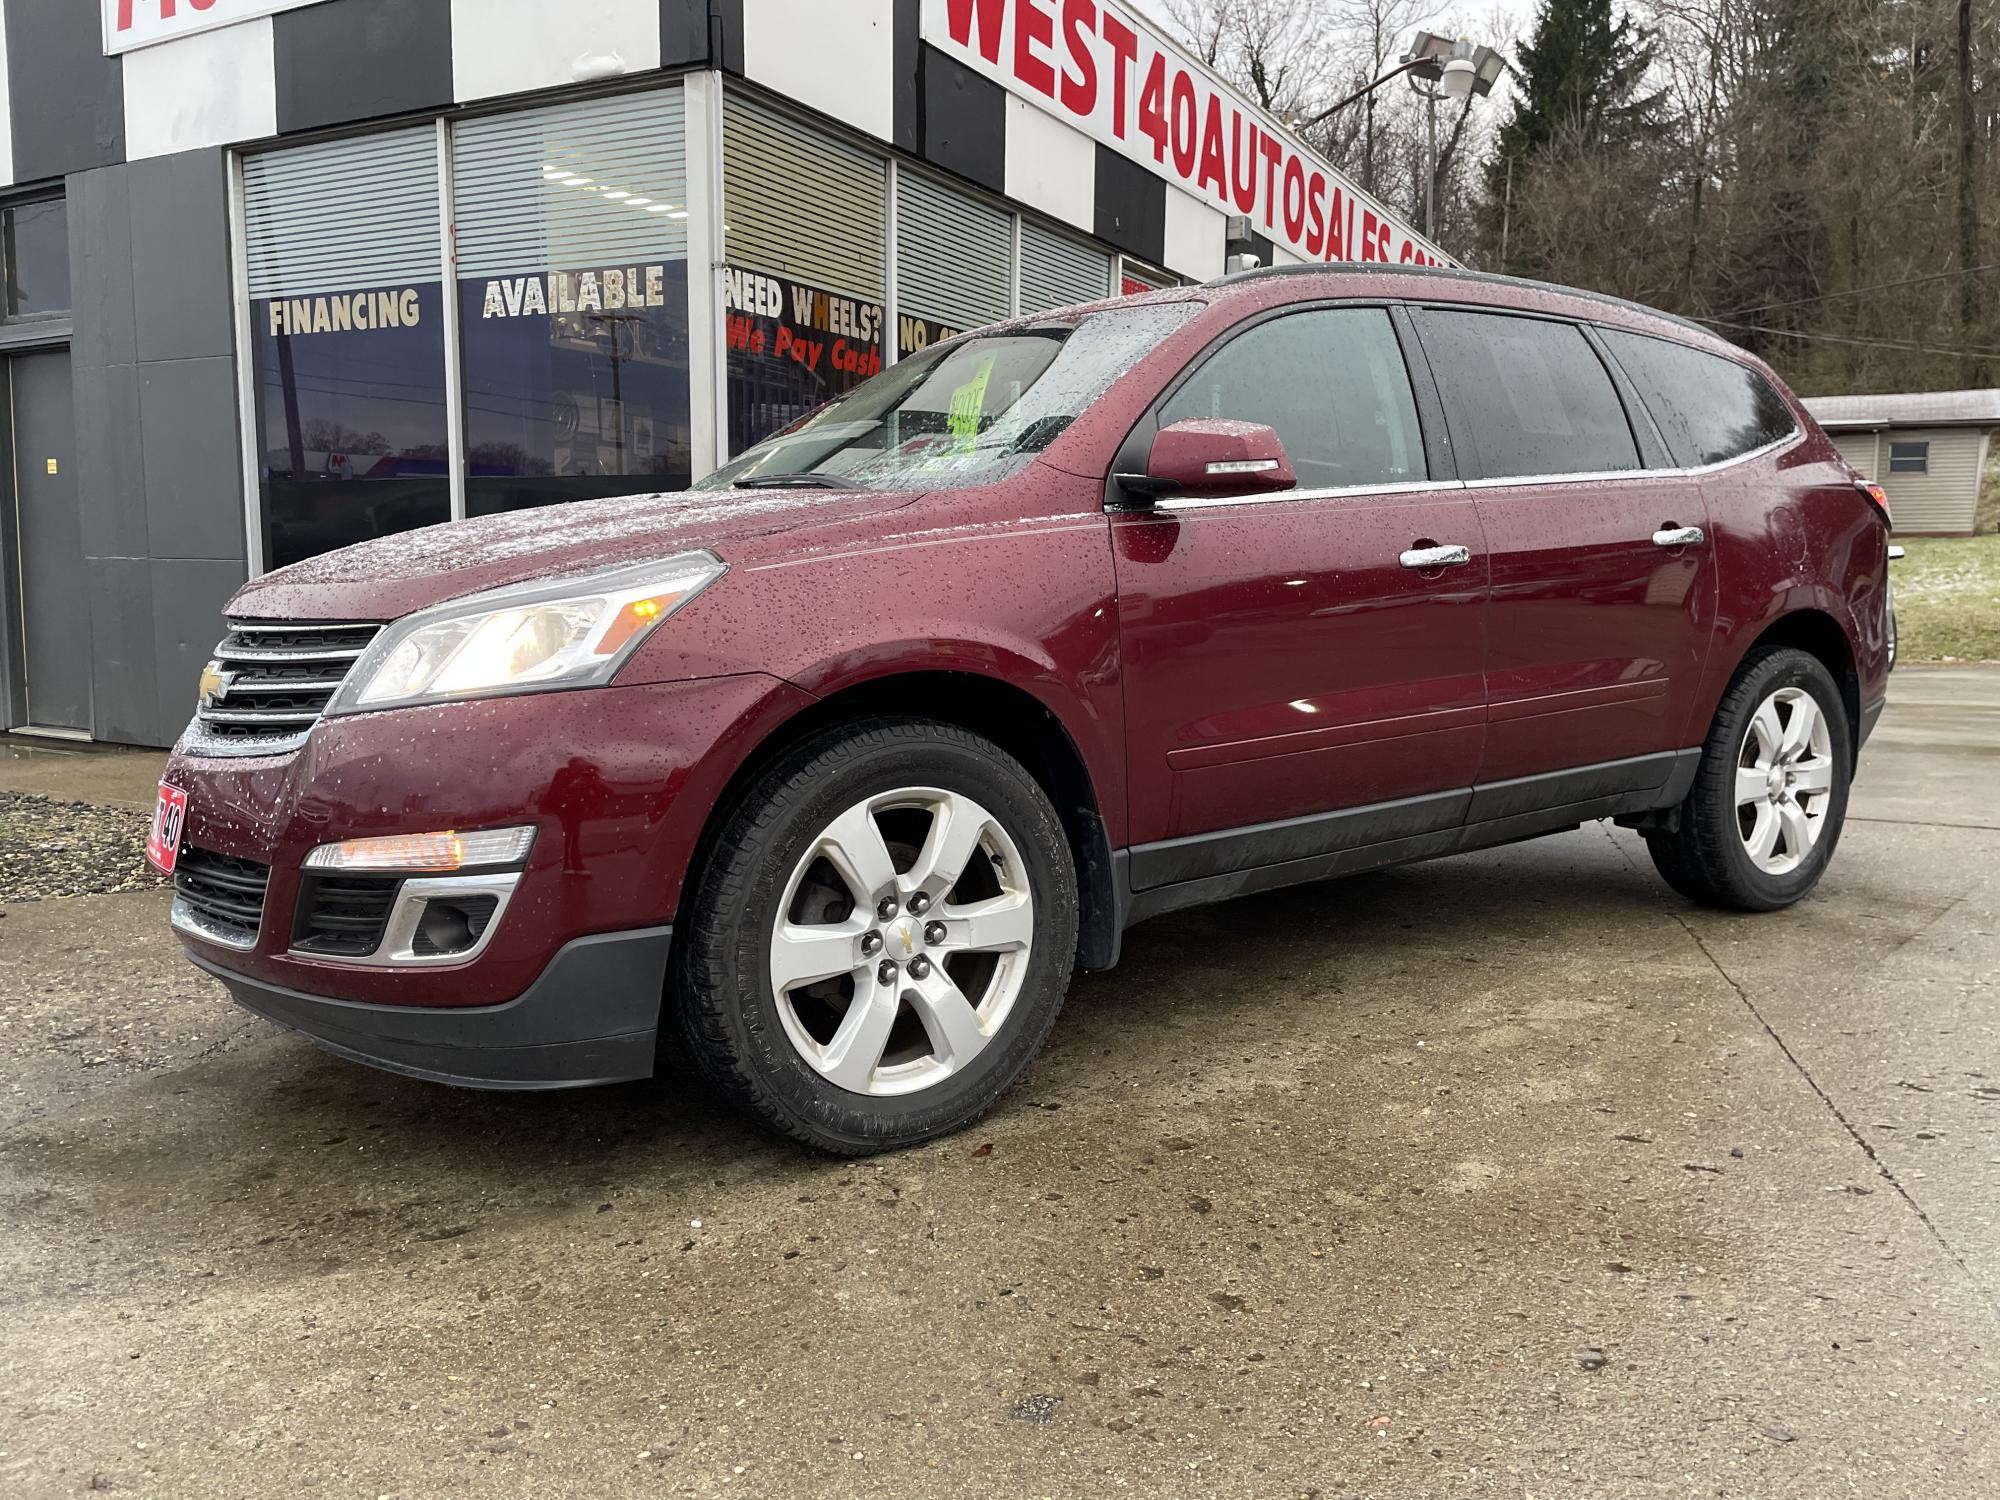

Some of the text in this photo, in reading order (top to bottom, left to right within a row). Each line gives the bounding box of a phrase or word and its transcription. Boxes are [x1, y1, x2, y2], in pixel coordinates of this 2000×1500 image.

[270, 265, 664, 336] FINANCING AVAILABLE
[724, 267, 927, 352] NEED WHEELS? NO
[726, 313, 880, 377] We Pay Cash
[162, 802, 181, 852] 40
